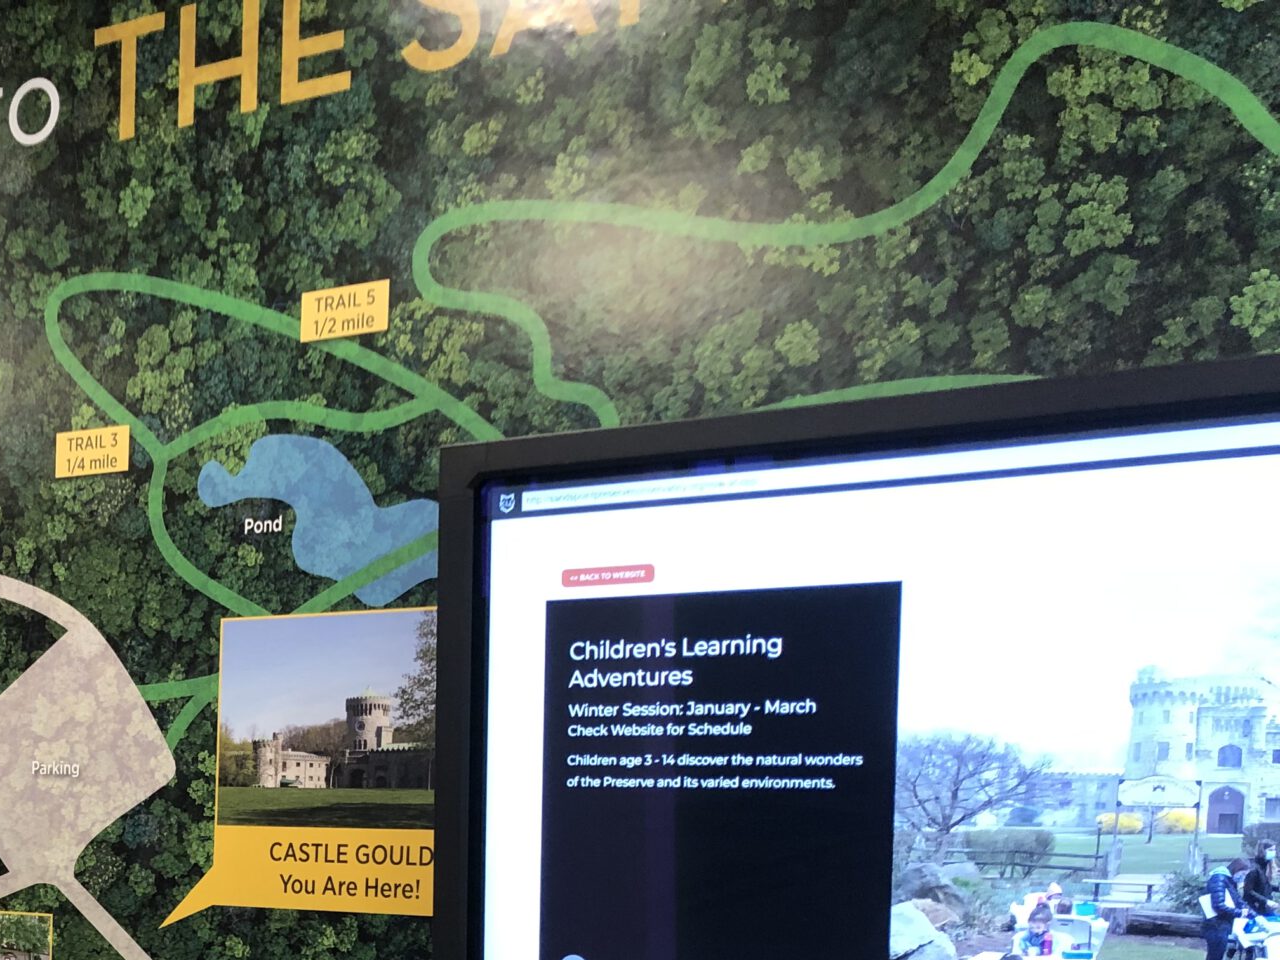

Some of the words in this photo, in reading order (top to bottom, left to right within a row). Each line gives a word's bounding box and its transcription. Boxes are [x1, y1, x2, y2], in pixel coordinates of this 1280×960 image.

[93, 0, 352, 141] THE
[314, 294, 357, 313] TRAIL
[366, 292, 376, 307] 5
[313, 317, 338, 337] 1/2
[341, 313, 376, 331] mile
[67, 435, 106, 452] TRAIL
[110, 435, 119, 450] 3
[66, 457, 86, 474] 1/4
[89, 454, 118, 471] mile
[244, 515, 283, 535] Pond
[579, 572, 600, 581] BACK
[601, 572, 611, 580] TO
[569, 638, 677, 661] Children's
[681, 634, 783, 659] Learning
[568, 668, 693, 688] Adventures
[568, 702, 619, 717] Winter
[622, 701, 683, 717] Session:
[686, 700, 751, 718] January
[764, 698, 816, 715] March
[567, 724, 608, 737] Check
[610, 723, 664, 736] Website
[666, 722, 685, 735] for
[687, 722, 752, 735] Schedule
[31, 760, 80, 779] Parking
[566, 754, 617, 767] Children
[619, 757, 642, 768] age
[644, 755, 652, 766] 3
[661, 755, 676, 766] 14
[677, 754, 729, 766] discover
[731, 754, 754, 766] the
[756, 753, 802, 766] natural
[804, 753, 864, 766] wonders
[566, 776, 579, 787] of
[580, 776, 601, 787] the
[603, 776, 655, 788] Preserve
[656, 776, 681, 788] and
[683, 776, 699, 788] its
[700, 776, 740, 789] varied
[741, 776, 836, 789] environments.
[269, 842, 348, 864] CASTLE
[355, 844, 434, 867] GOULD
[280, 874, 315, 894] You
[322, 876, 358, 896] Are
[364, 877, 421, 899] Here!
